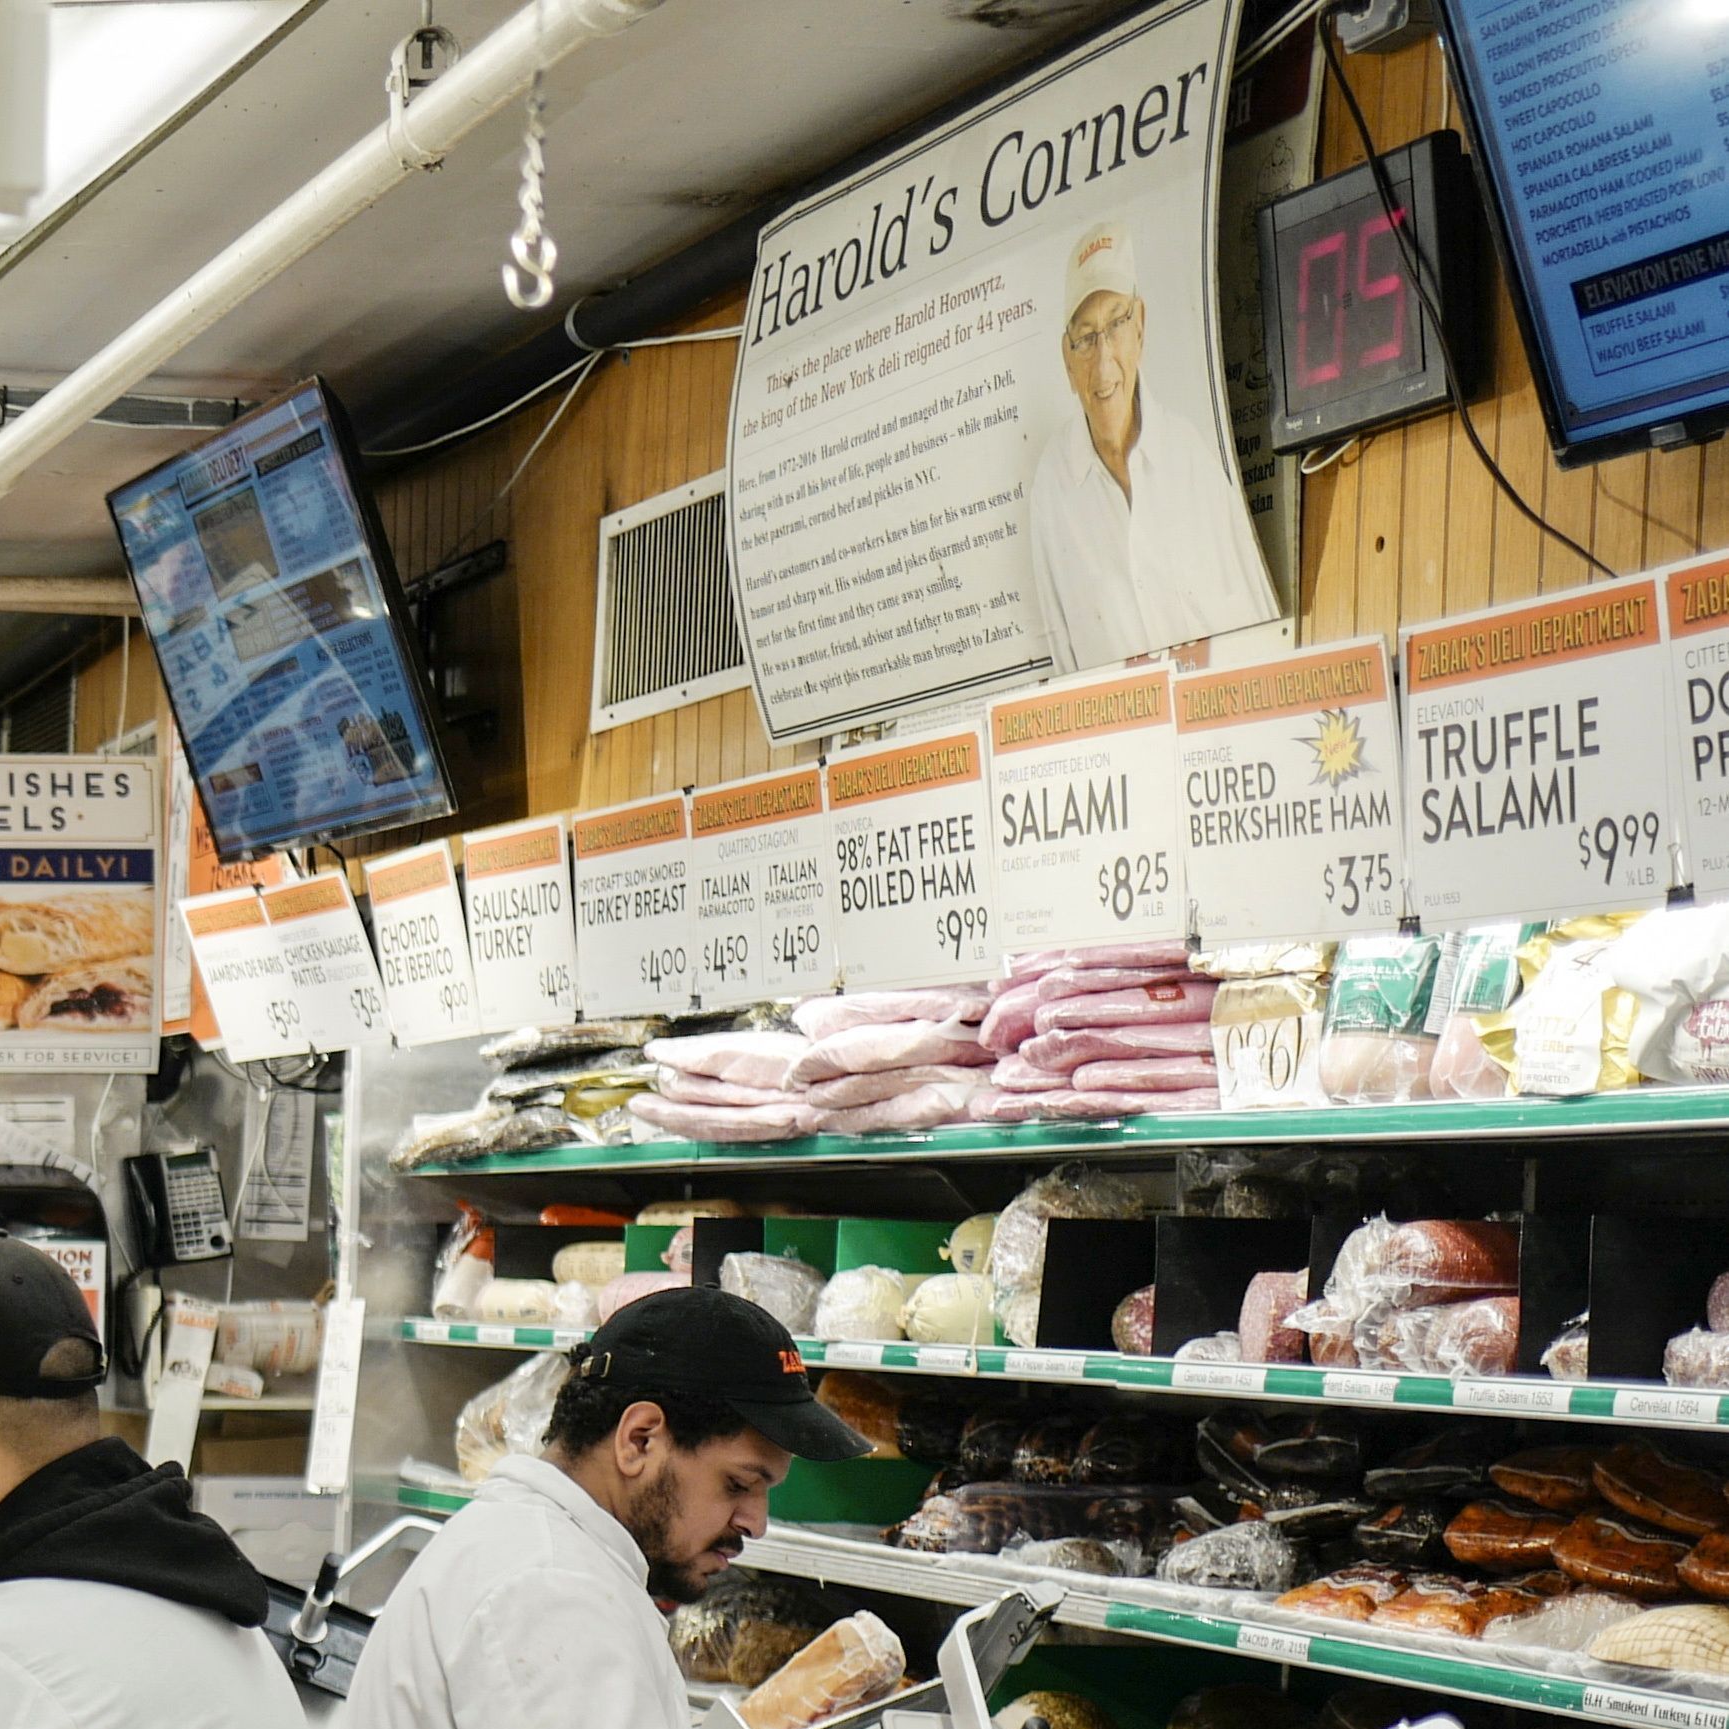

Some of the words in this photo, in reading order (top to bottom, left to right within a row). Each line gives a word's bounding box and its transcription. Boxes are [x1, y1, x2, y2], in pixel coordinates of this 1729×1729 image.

[1504, 107, 1536, 132] SWEET
[1537, 82, 1601, 118] CAPOCOLLO
[1511, 135, 1533, 154] HOT
[1533, 110, 1596, 145] CAPOCOLLO
[1517, 151, 1565, 177] SPIANATA
[1566, 132, 1612, 156] ROMANA
[1613, 113, 1654, 136] SALAMI
[1523, 174, 1571, 199] SPIANATA
[1571, 148, 1631, 182] CALABRESE
[1632, 134, 1672, 160] SALAMI
[750, 176, 957, 347] Harold's
[980, 62, 1208, 228] Corner
[1542, 235, 1610, 267] MORTADELLA
[1627, 205, 1691, 237] PISTACHIOS
[766, 373, 787, 394] This
[802, 357, 820, 379] the
[823, 347, 852, 376] place
[855, 326, 891, 360] where
[894, 300, 935, 337] Harold
[939, 274, 1005, 316] Horowytz,
[1590, 315, 1634, 339] TRUFFLE
[1635, 301, 1676, 326] SALAMI
[1597, 341, 1635, 363] WAGYU
[1637, 333, 1663, 352] BEEF
[1664, 320, 1705, 344] SALAMI
[743, 416, 757, 438] the
[761, 409, 783, 430] king
[786, 397, 798, 419] of
[800, 391, 818, 412] the
[821, 379, 846, 404] New
[849, 364, 875, 391] York
[878, 353, 900, 378] deli
[904, 330, 951, 367] reigned
[954, 324, 973, 346] for
[976, 310, 993, 335] 44
[997, 298, 1037, 332] years.
[1418, 633, 1486, 681] ZABAR'S
[1489, 624, 1525, 666] DELI
[1530, 596, 1647, 657] DEPARTMENT
[1182, 683, 1239, 723] ZABAR'S
[1242, 677, 1273, 714] DELI
[1276, 658, 1373, 708] DEPARTMENT
[1417, 697, 1484, 725] ELEVATION
[998, 707, 1042, 745] ZABAR'S
[1046, 701, 1071, 734] DELI
[1074, 684, 1162, 731] DEPARTMENT
[1183, 746, 1233, 768] HERITAGE
[1418, 697, 1600, 783] TRUFFLE
[834, 768, 874, 801] ZABAR'S
[875, 759, 898, 793] DELI
[900, 744, 971, 785] DEPARTMENT
[1030, 759, 1068, 779] ROSETTE
[1070, 757, 1083, 774] DE
[1084, 752, 1110, 771] LYON
[1187, 761, 1276, 808] CURED
[1002, 773, 1128, 847] SALAMI
[1190, 798, 1323, 848] BERKSHIRE
[1330, 789, 1391, 830] HAM
[1421, 765, 1576, 844] SALAMI
[718, 838, 756, 861] QUATTRO
[757, 828, 799, 853] STAGIONI
[836, 833, 872, 874] 98%
[877, 826, 911, 865] FAT
[918, 814, 975, 858] FREE
[10, 855, 129, 878] DAILY!
[624, 868, 647, 886] SLOW
[647, 860, 686, 880] SMOKED
[701, 870, 750, 901] ITALIAN
[768, 857, 817, 887] ITALIAN
[840, 868, 914, 914] BOILED
[921, 857, 976, 903] HAM
[472, 880, 561, 926] SAULSALITO
[580, 891, 631, 927] TURKEY
[634, 883, 687, 919] BREAST
[698, 896, 755, 920] PARMACOTTO
[764, 881, 824, 905] PARMACOTTO
[284, 940, 325, 967] CHICKEN
[325, 934, 361, 957] SAUSAGE
[381, 914, 440, 956] CHORIZO
[474, 923, 533, 962] TURKEY
[208, 962, 244, 985] JAMBON
[245, 960, 258, 976] DE
[259, 956, 284, 976] PARIS
[291, 965, 326, 988] PATTIES
[385, 958, 404, 988] DE
[404, 947, 453, 984] IBERICO
[24, 1050, 55, 1063] FOR
[62, 1050, 139, 1064] SERVICE!
[1208, 1372, 1232, 1385] Salami
[1468, 1387, 1495, 1402] Truffle
[1497, 1389, 1528, 1405] Salami
[1530, 1391, 1553, 1406] 1553
[1630, 1396, 1670, 1414] Cervelat
[1674, 1399, 1699, 1415] 1564
[1606, 1696, 1649, 1716] Smoked
[1653, 1704, 1691, 1727] Turkey
